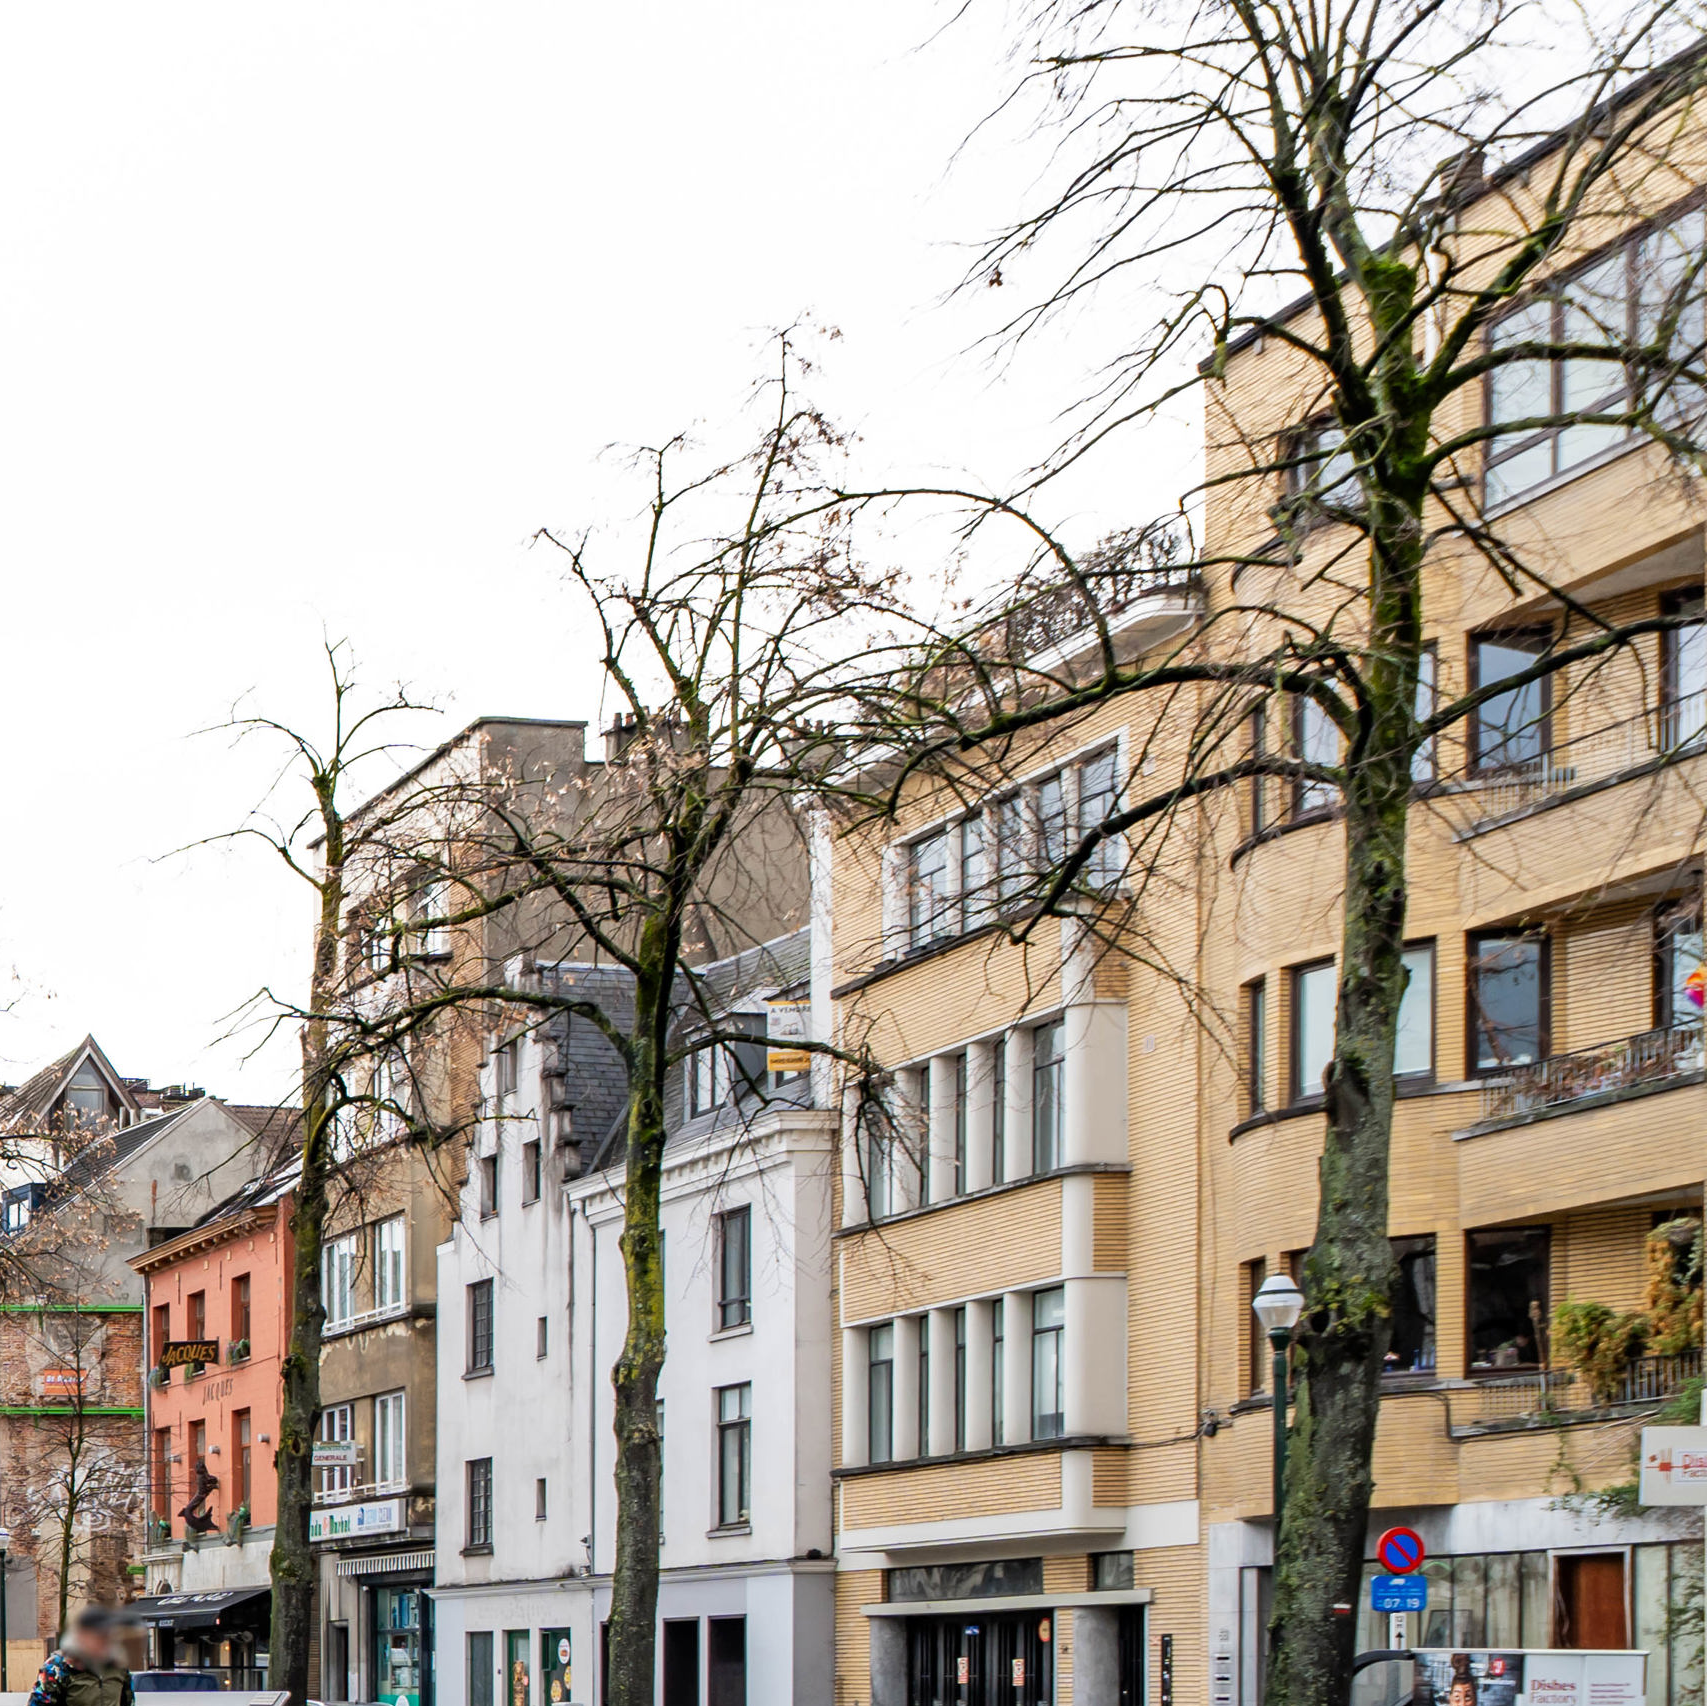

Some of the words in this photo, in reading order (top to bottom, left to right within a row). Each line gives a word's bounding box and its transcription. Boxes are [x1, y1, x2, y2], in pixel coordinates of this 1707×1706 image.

[162, 1344, 216, 1366] JACQUES
[203, 1378, 233, 1406] JACQUES
[314, 1454, 348, 1462] GENERALE
[1530, 1680, 1577, 1691] Dishes
[1530, 1692, 1577, 1706] Factory
